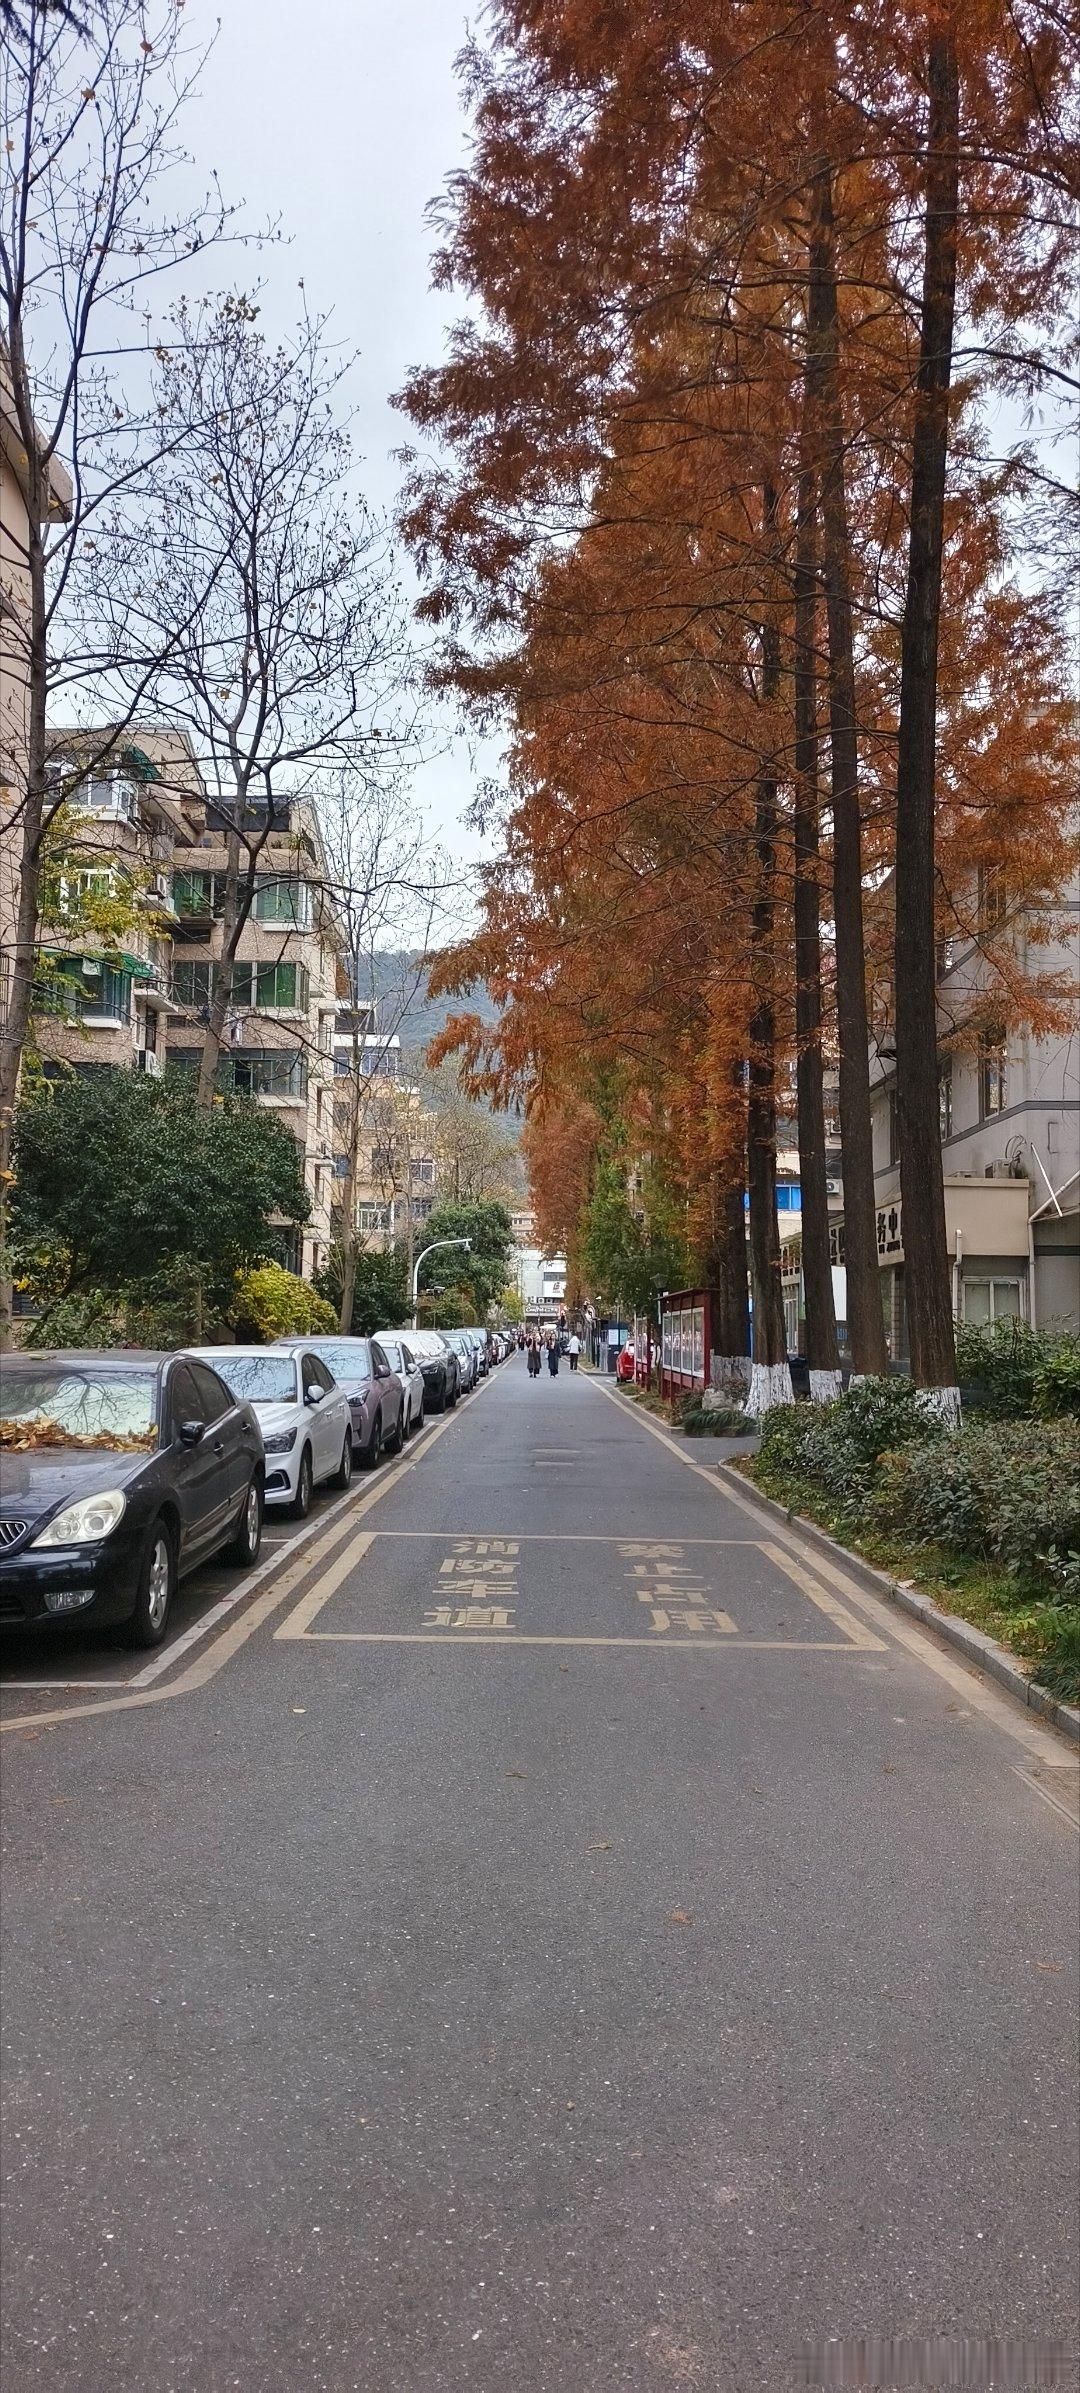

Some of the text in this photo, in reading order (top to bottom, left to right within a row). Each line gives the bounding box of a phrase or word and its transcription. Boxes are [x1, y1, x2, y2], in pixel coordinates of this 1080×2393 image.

[421, 1540, 521, 1629] 消防车道
[615, 1544, 740, 1633] 禁止占用
